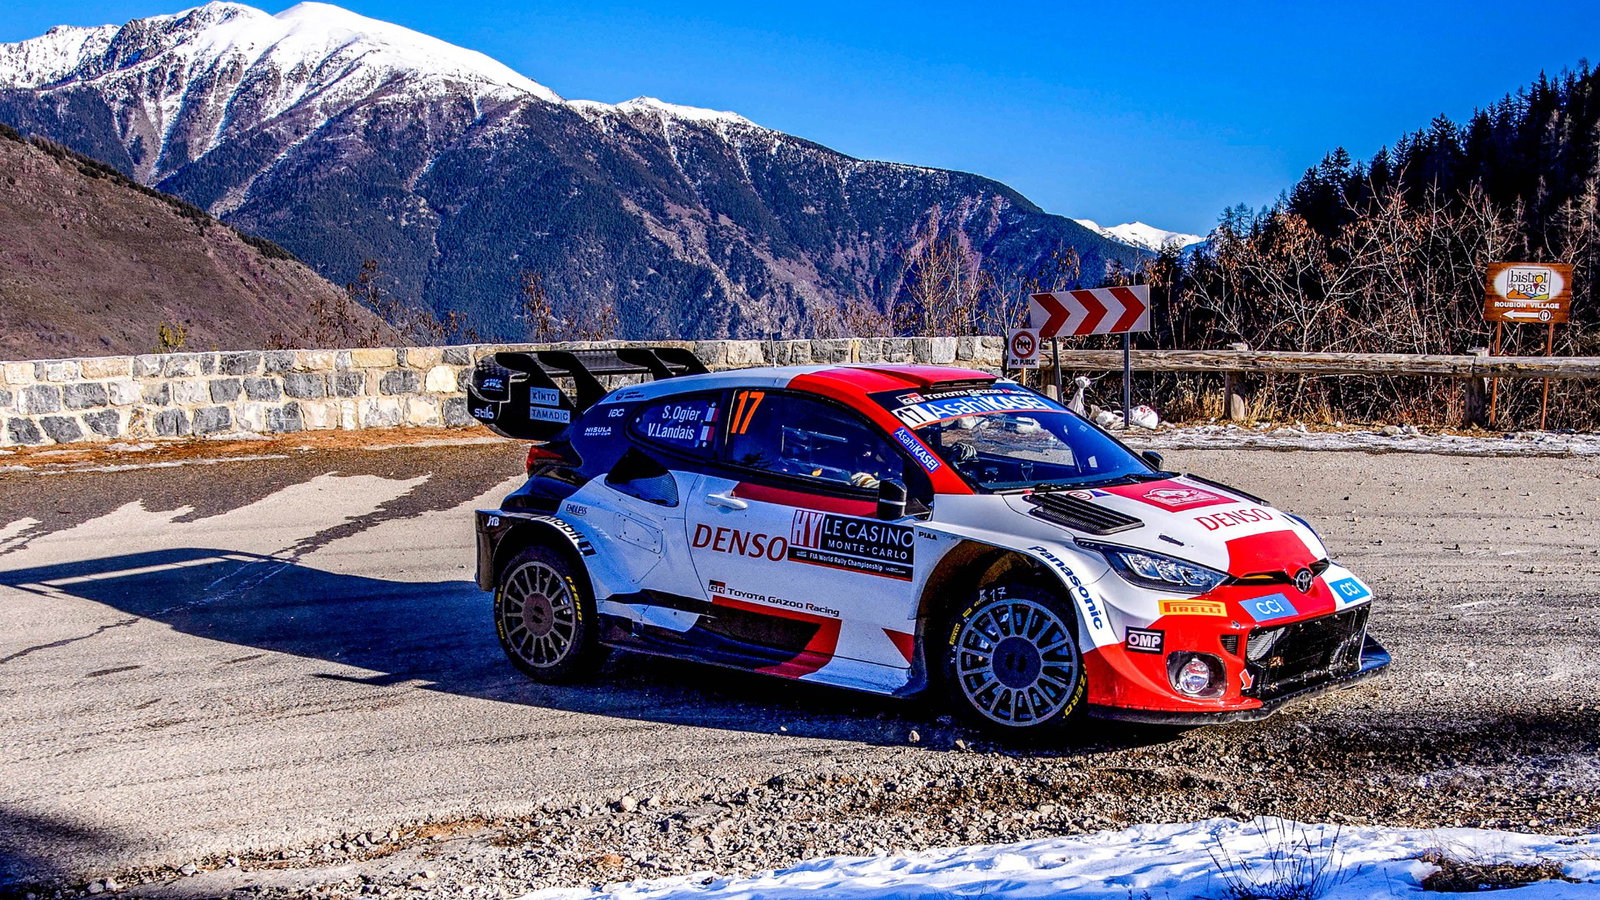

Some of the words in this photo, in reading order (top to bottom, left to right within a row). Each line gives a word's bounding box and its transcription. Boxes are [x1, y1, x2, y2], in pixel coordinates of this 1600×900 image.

[1510, 270, 1548, 283] bistrot
[1517, 282, 1546, 295] pays
[532, 391, 557, 402] KINTO
[531, 409, 569, 421] TAMADIC
[731, 391, 765, 434] 17
[899, 406, 926, 424] 17
[647, 423, 695, 439] V.Landais
[1193, 508, 1273, 531] DENSO
[791, 510, 824, 549] HY
[824, 518, 841, 535] LE
[845, 522, 915, 548] CASINO
[918, 531, 937, 541] PIAA
[692, 523, 788, 562] DENSO
[809, 552, 818, 560] FIA
[819, 554, 833, 563] World
[834, 556, 847, 566] Rally
[847, 558, 883, 572] Championship
[1027, 546, 1103, 630] Panasonic
[727, 587, 766, 602] TOYOTA
[806, 603, 840, 617] Racing
[1164, 601, 1223, 615] PIRELLI
[1127, 633, 1161, 648] OMP
